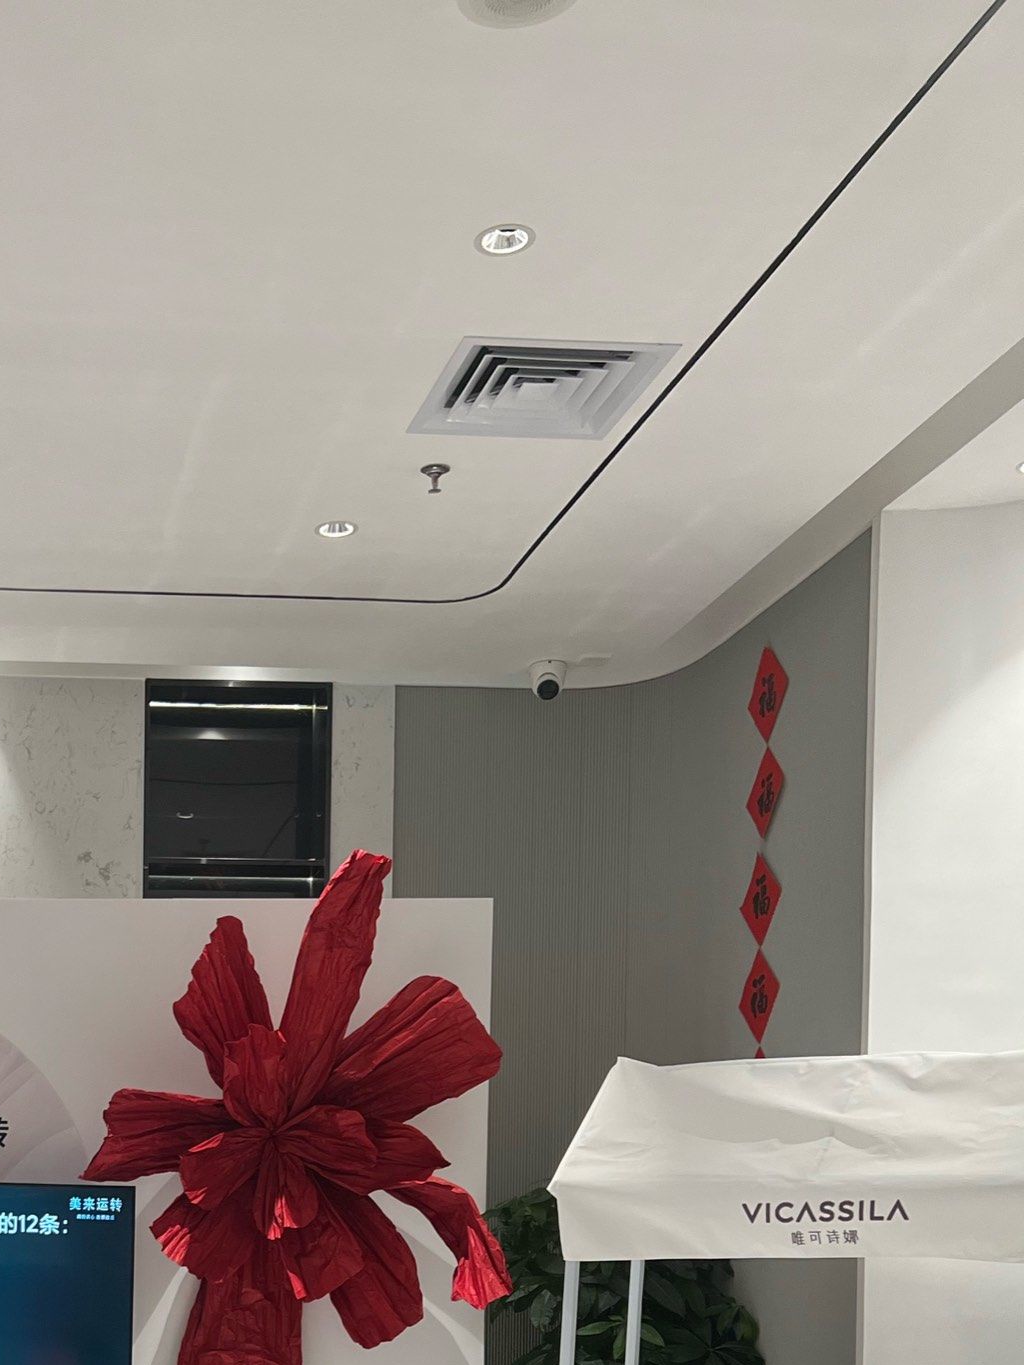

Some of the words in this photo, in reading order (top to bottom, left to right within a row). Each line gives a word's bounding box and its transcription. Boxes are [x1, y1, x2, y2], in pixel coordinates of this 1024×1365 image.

[69, 1196, 123, 1212] 美来运转
[742, 1199, 909, 1224] VICASSILA
